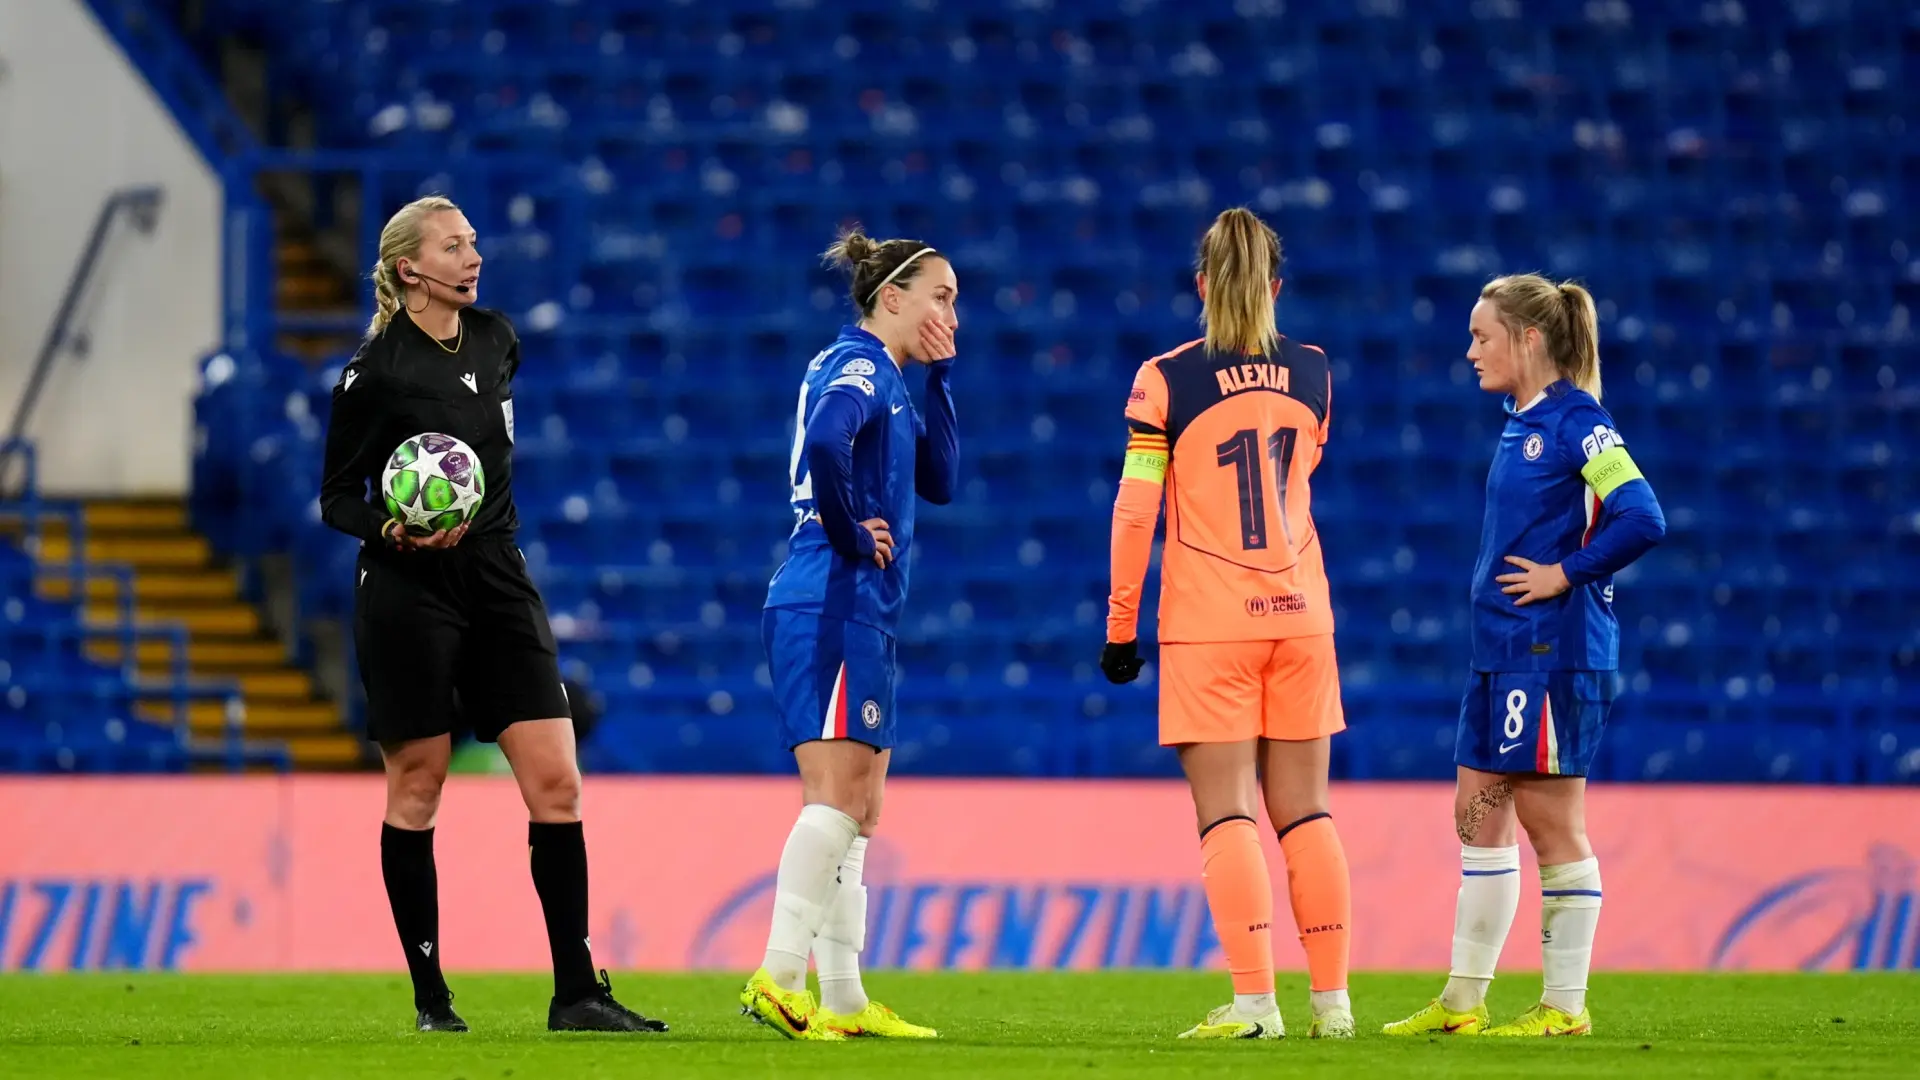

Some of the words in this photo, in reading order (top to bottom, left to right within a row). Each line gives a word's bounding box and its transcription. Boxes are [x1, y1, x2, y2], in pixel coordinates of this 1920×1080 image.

[1215, 364, 1290, 395] ALEXIA
[1593, 461, 1623, 484] RESPECT
[1216, 426, 1298, 550] 11
[1271, 592, 1305, 604] UNHCR
[1272, 601, 1307, 613] ACNUR
[1504, 689, 1527, 739] 8
[1248, 922, 1272, 932] BAR
